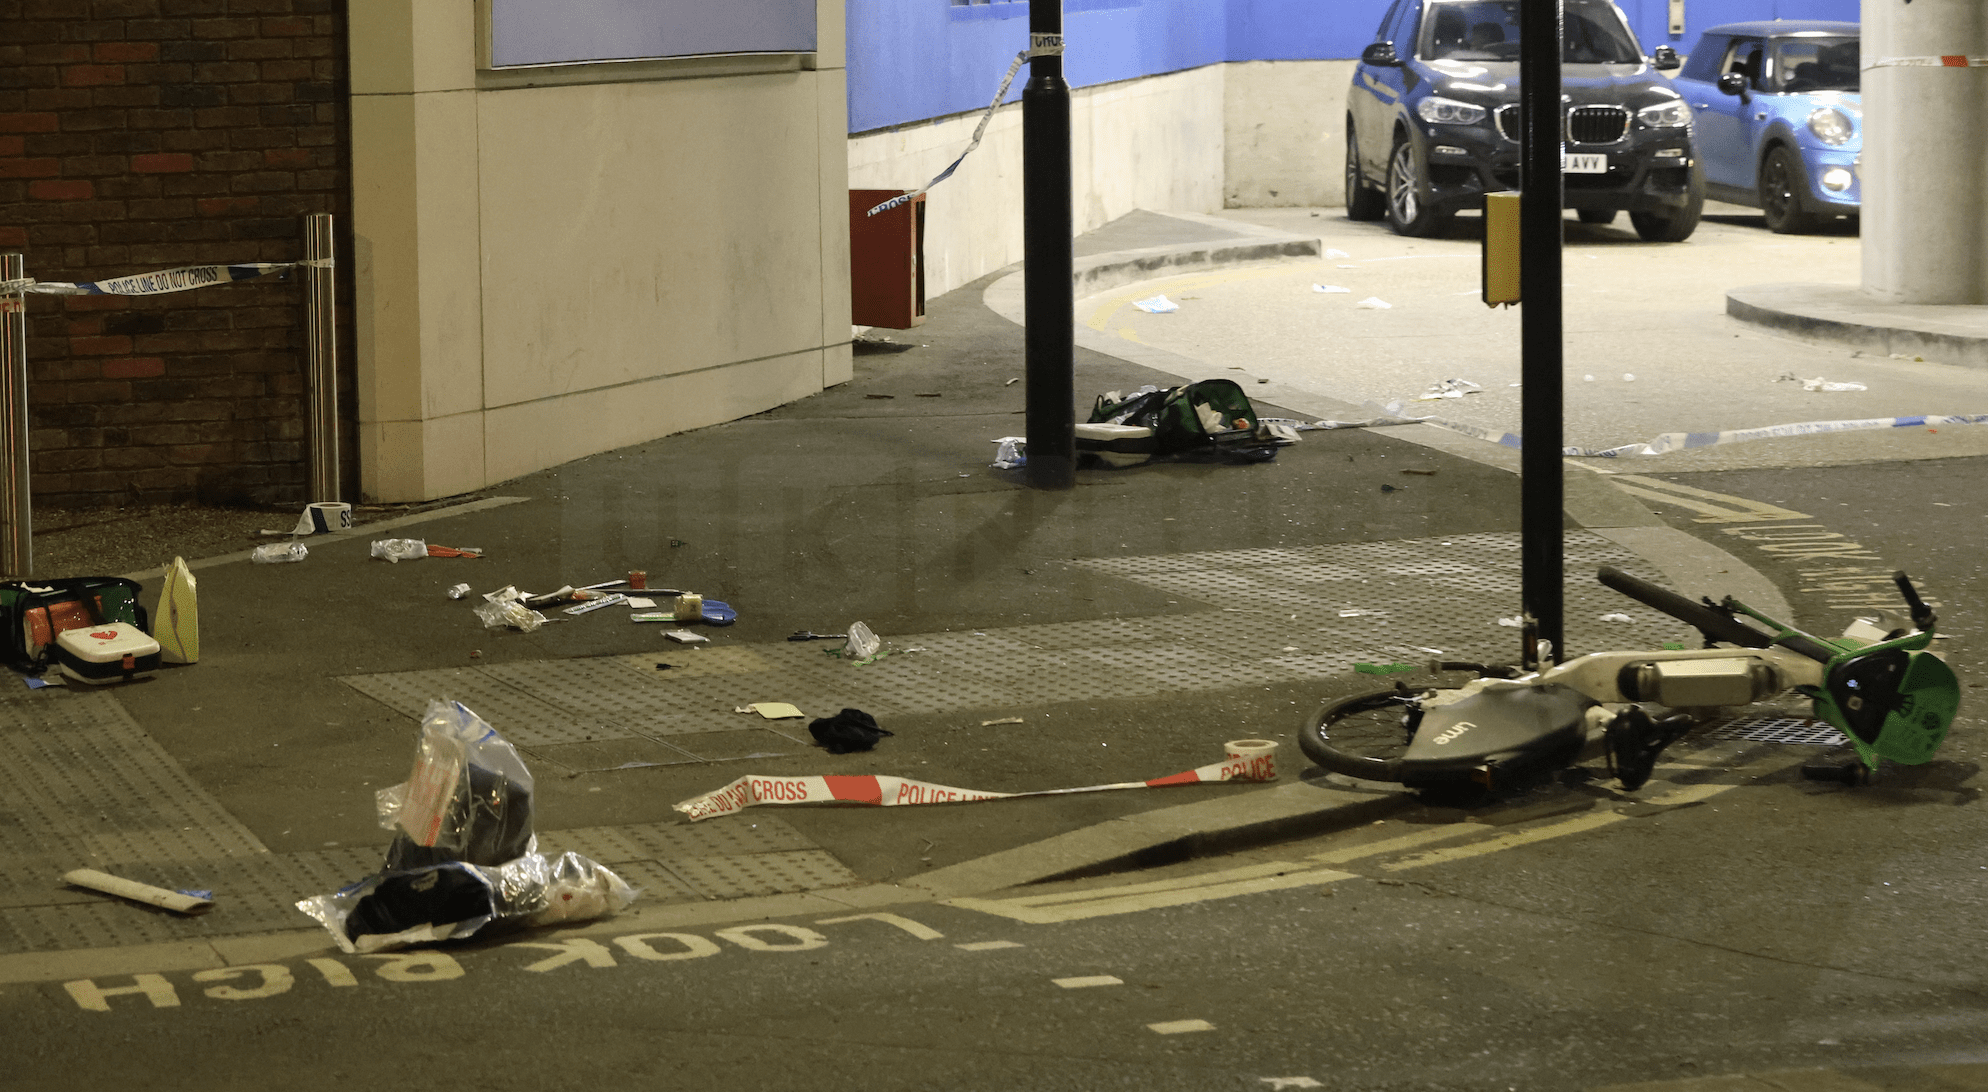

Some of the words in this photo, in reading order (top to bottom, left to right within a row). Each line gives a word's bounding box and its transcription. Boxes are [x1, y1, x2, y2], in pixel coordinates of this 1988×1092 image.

[108, 278, 140, 294] POLICE
[135, 275, 157, 293] LINE
[155, 272, 170, 291] DO
[168, 269, 187, 289] NOT
[187, 265, 218, 286] CROSS
[1220, 754, 1276, 781] POLICE
[709, 794, 733, 812] DO
[751, 779, 808, 802] CROSS
[897, 782, 957, 805] POLICE
[502, 911, 945, 973] LOOK
